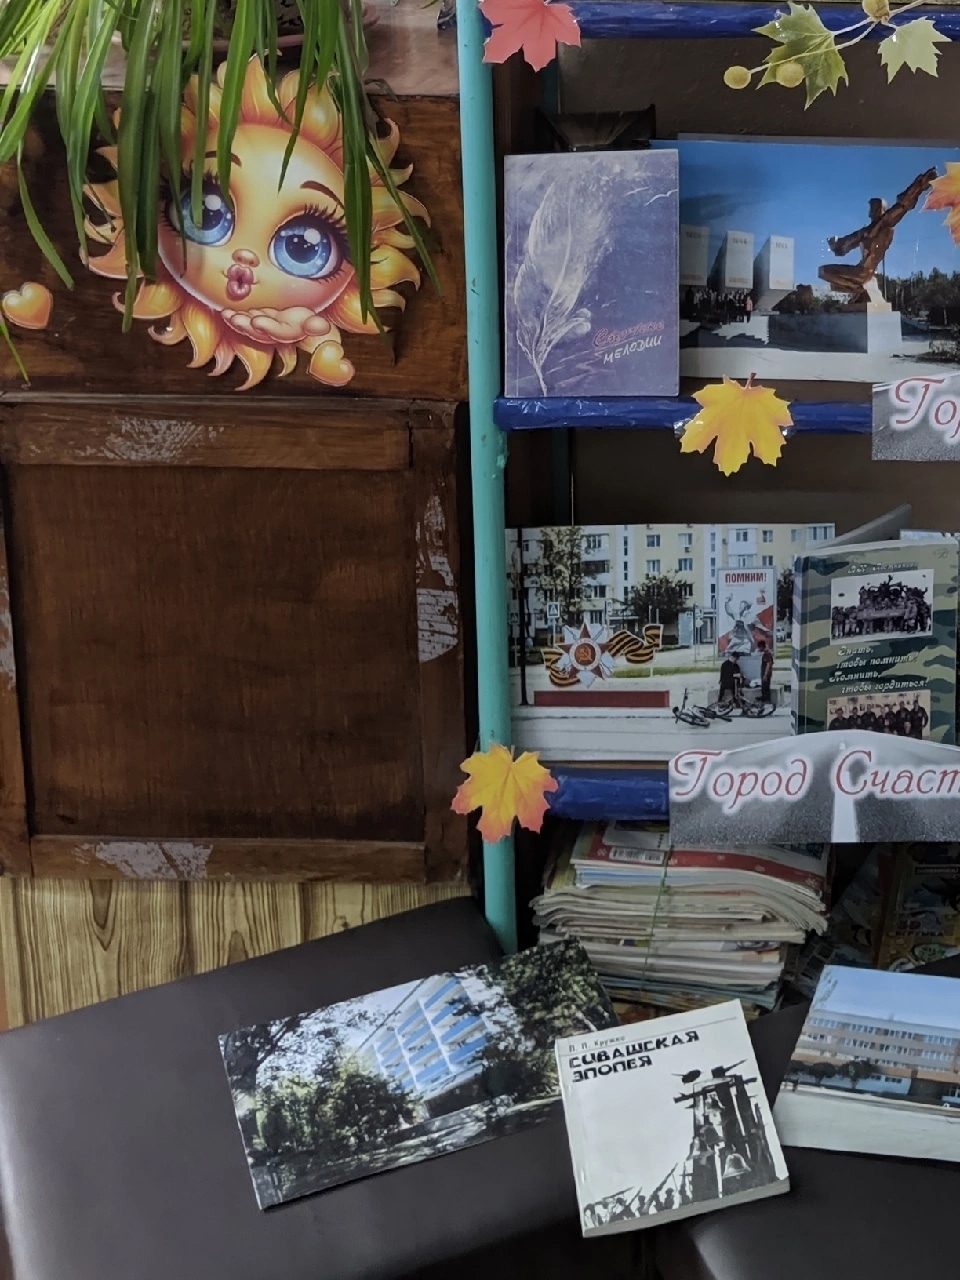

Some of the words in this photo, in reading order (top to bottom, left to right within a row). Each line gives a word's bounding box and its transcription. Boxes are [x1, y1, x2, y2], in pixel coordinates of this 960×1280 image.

[603, 335, 662, 365] МЕЛОДИИ
[725, 573, 767, 583] ПОМНИМ!
[673, 750, 808, 810] Город
[569, 1030, 700, 1069] СИВАШСКАЯ
[572, 1056, 653, 1083] ЭПОПЕЯ
